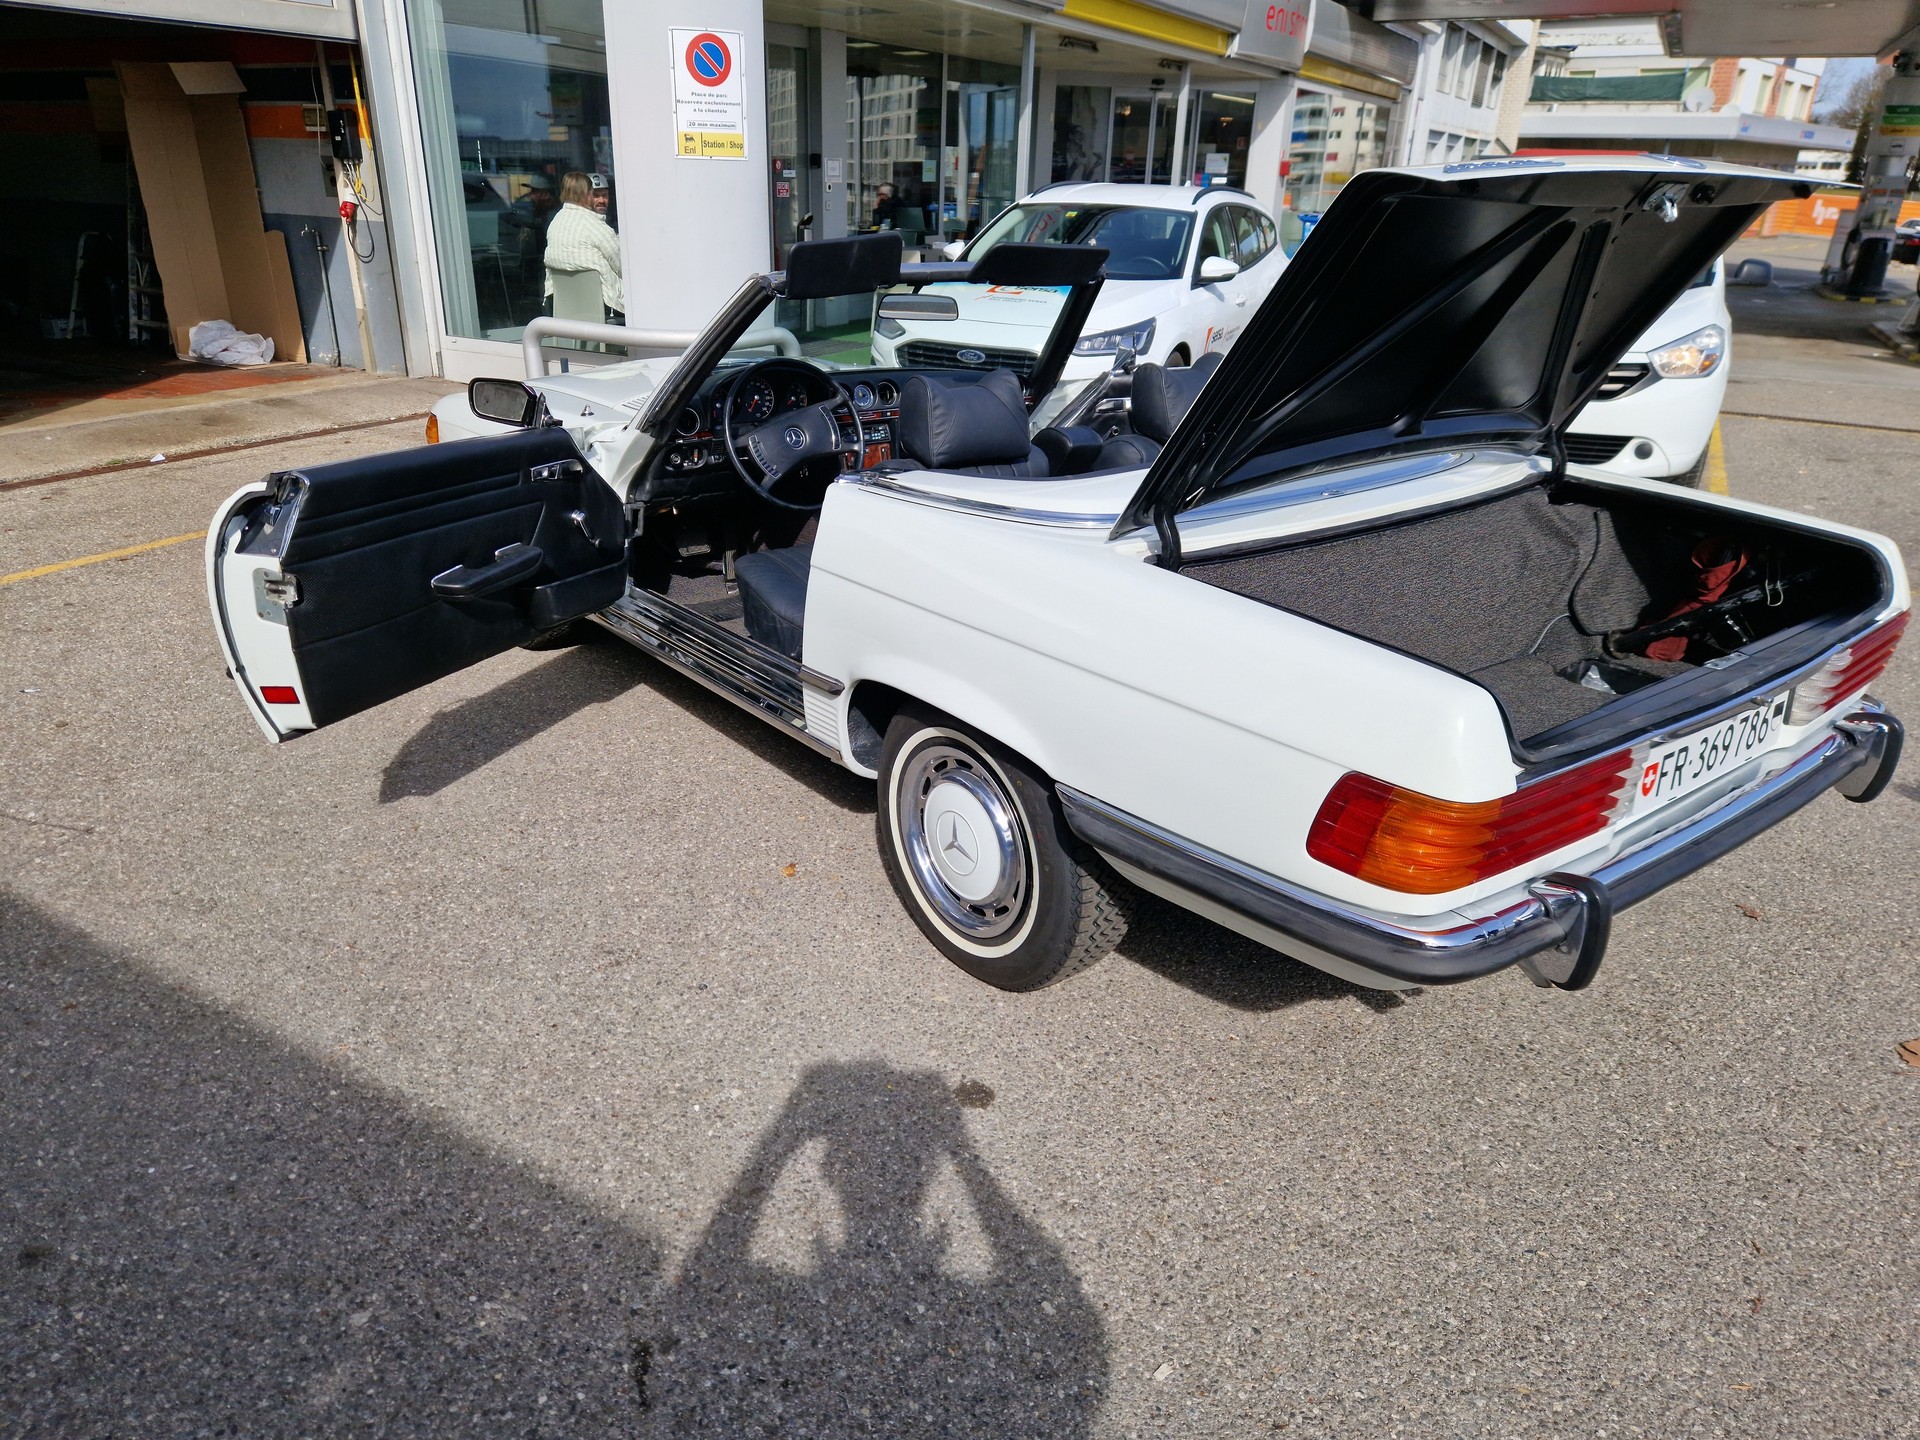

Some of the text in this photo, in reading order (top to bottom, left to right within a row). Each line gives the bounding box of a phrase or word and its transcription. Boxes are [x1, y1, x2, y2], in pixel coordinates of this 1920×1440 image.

[684, 146, 696, 154] Eni
[703, 139, 725, 149] Station
[730, 140, 743, 151] Shop
